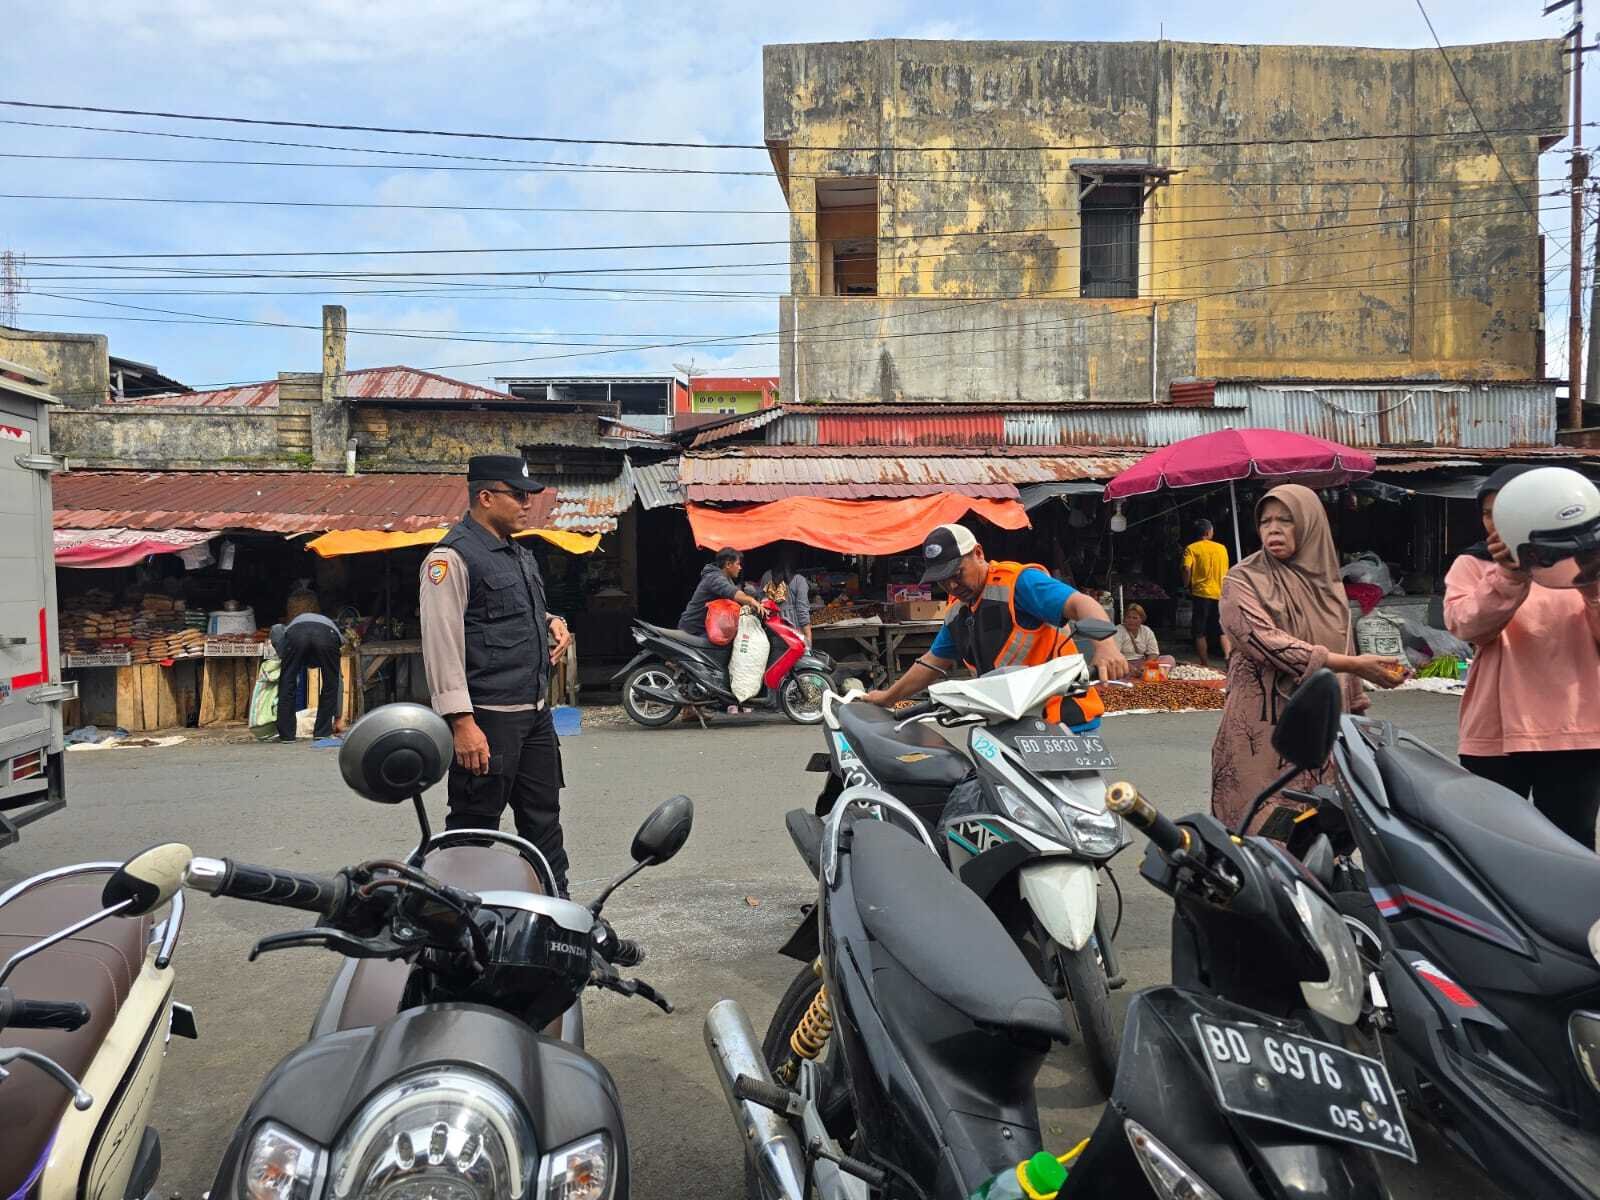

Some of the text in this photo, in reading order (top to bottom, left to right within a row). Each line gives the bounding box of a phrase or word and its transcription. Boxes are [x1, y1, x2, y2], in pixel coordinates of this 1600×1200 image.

[974, 735, 996, 759] 125
[1020, 739, 1040, 753] BD
[1083, 739, 1104, 754] KS
[550, 942, 588, 959] HONDA
[1204, 1023, 1388, 1105] BD 6976 H
